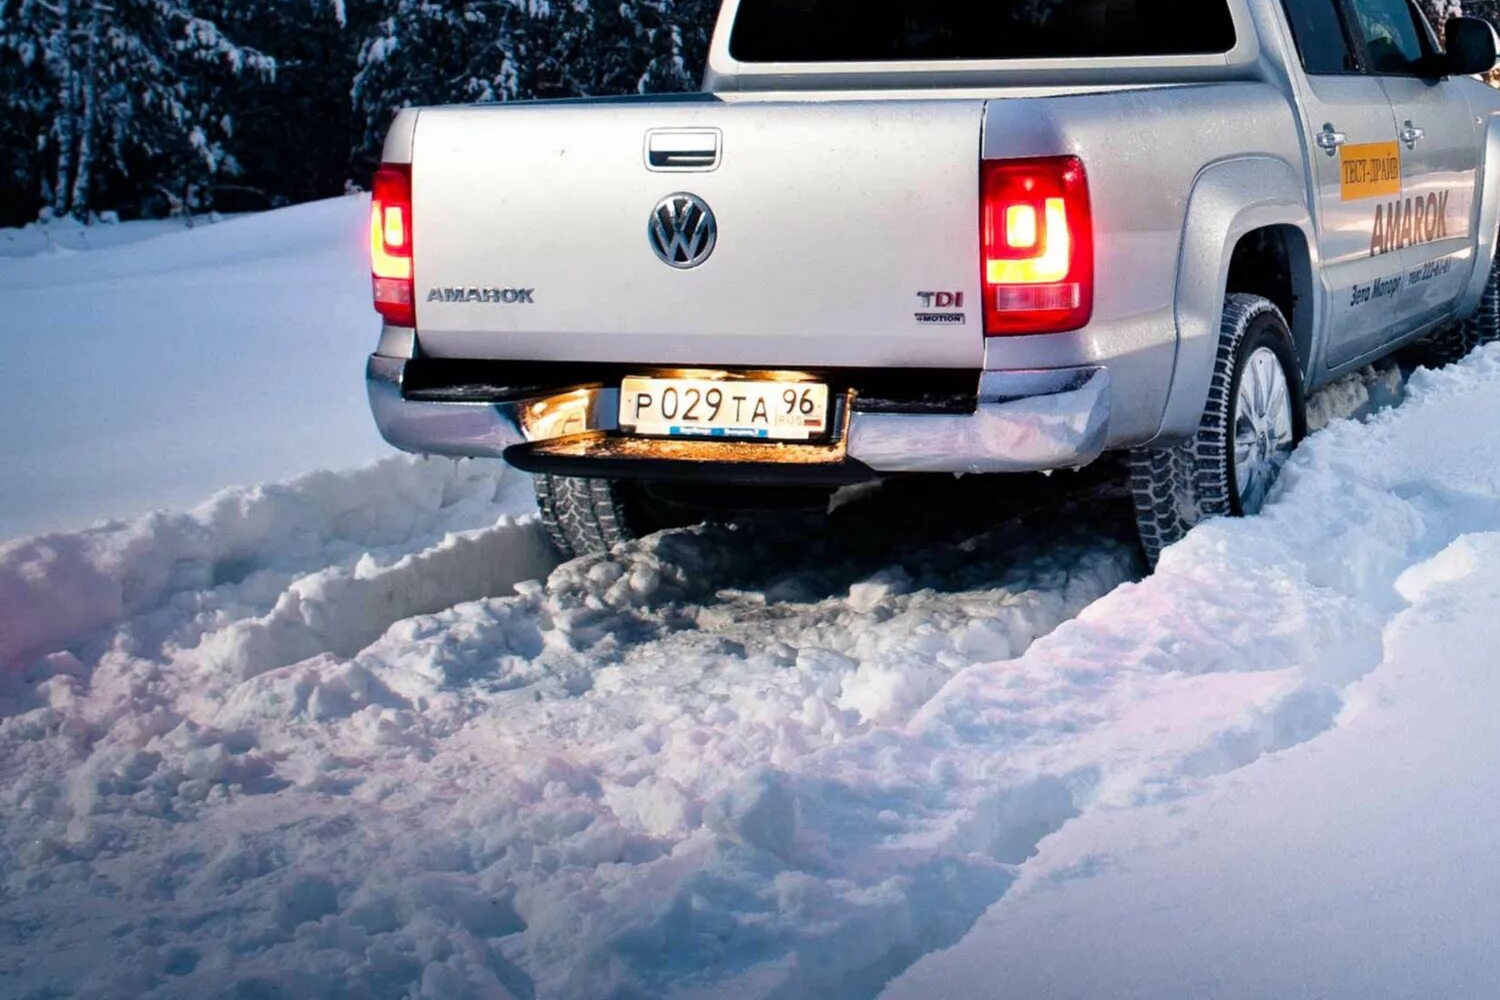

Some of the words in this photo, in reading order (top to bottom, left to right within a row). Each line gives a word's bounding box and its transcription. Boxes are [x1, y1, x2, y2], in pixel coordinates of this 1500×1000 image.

[1370, 190, 1449, 256] AMAROK
[426, 287, 535, 303] AMAROK
[916, 291, 963, 307] TDI
[782, 388, 814, 415] 96
